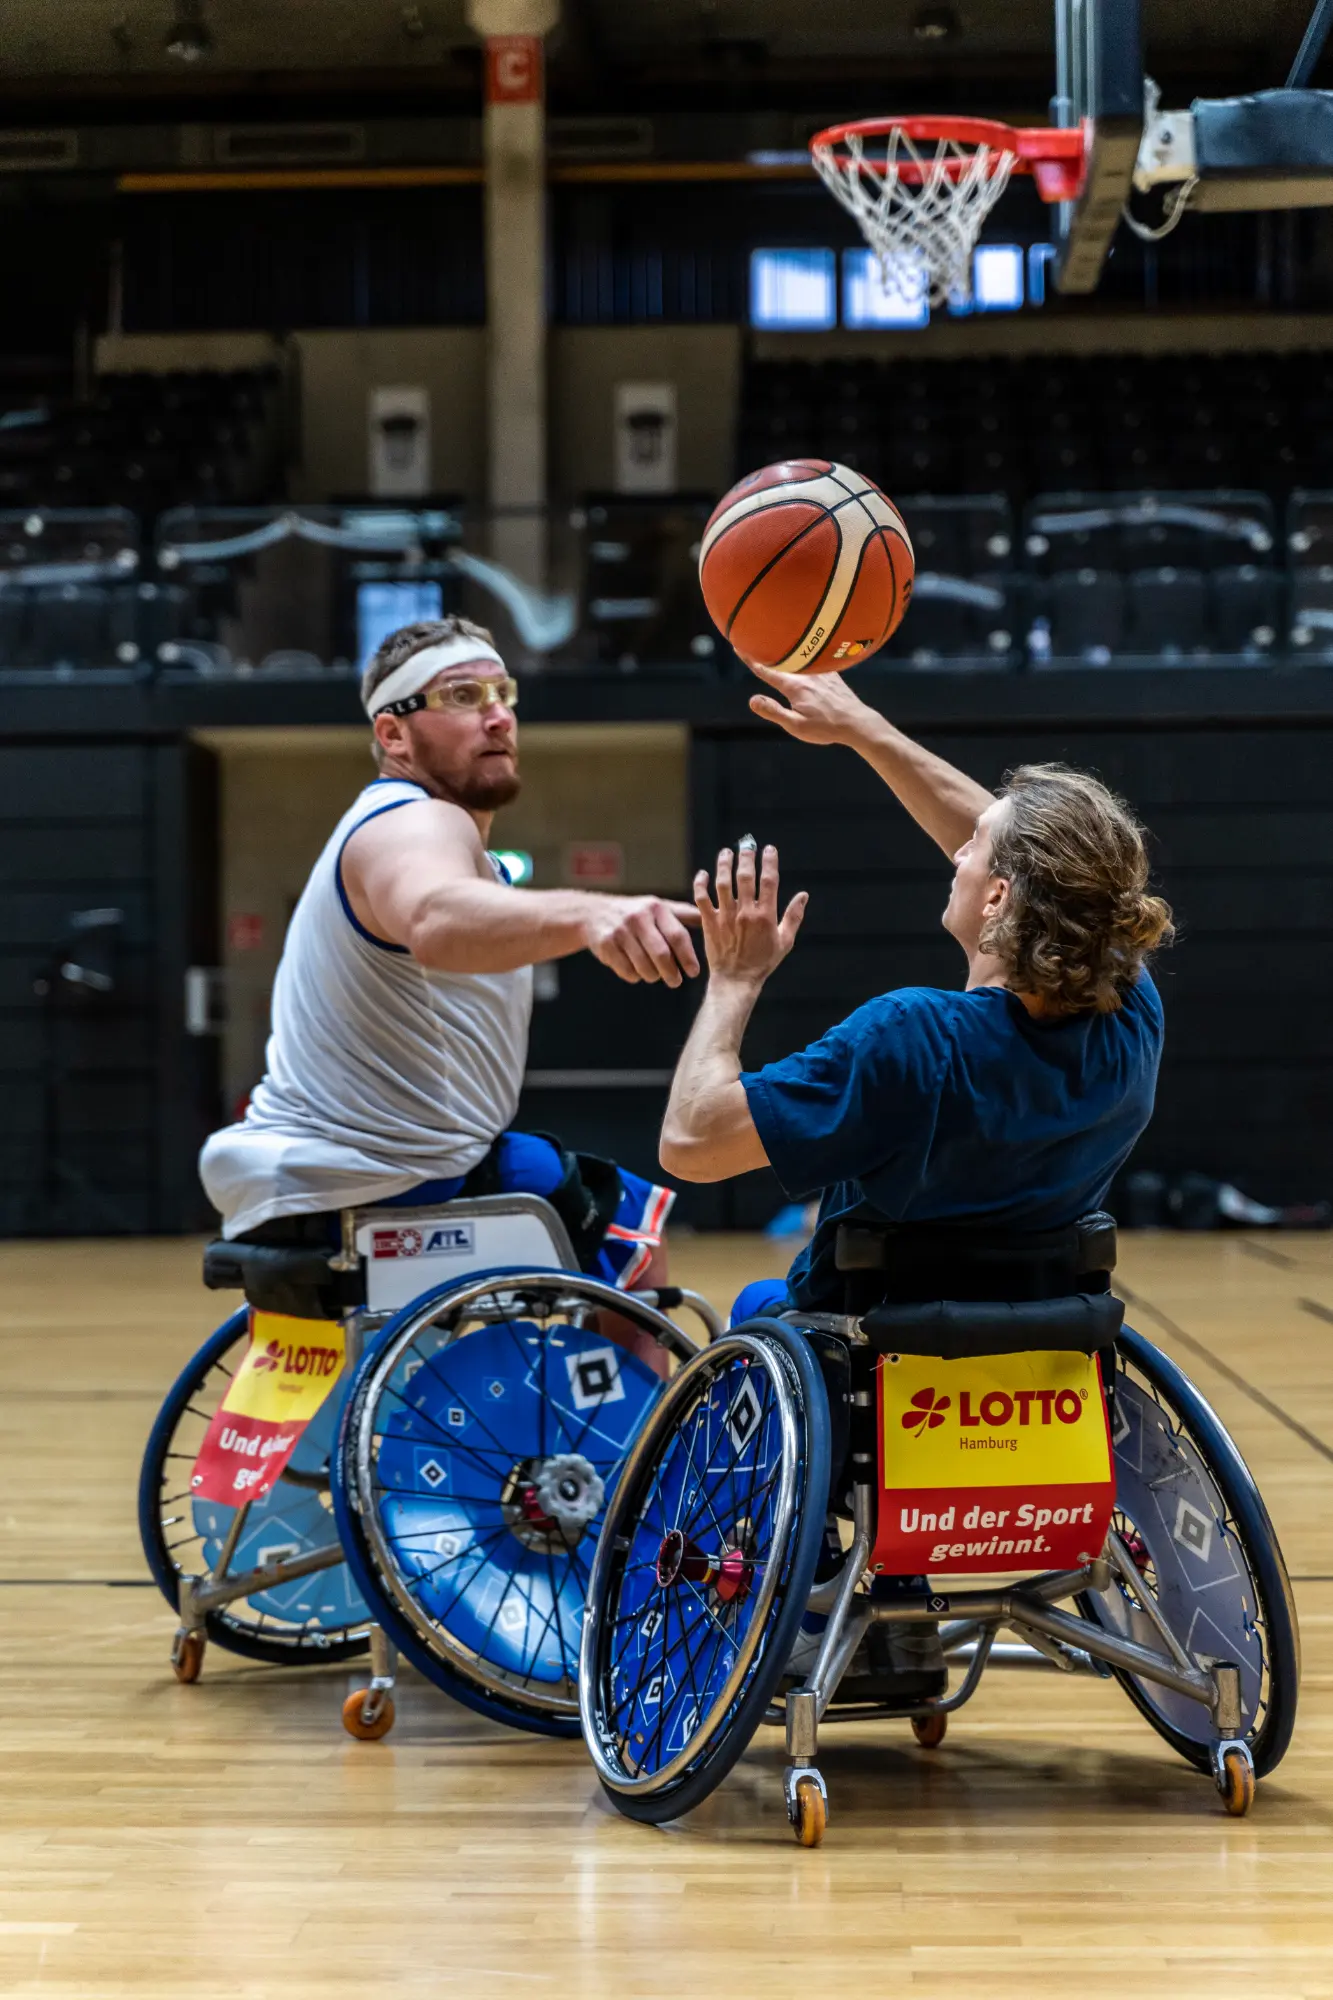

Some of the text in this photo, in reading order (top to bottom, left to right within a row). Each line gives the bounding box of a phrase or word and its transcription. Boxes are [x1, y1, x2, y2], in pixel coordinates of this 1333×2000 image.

[497, 51, 529, 88] C
[800, 626, 825, 658] GG7X
[219, 1427, 262, 1457] Und
[959, 1436, 1018, 1452] Hamburg
[900, 1503, 1094, 1533] Und der Sport
[928, 1535, 1052, 1562] gewinnt.
